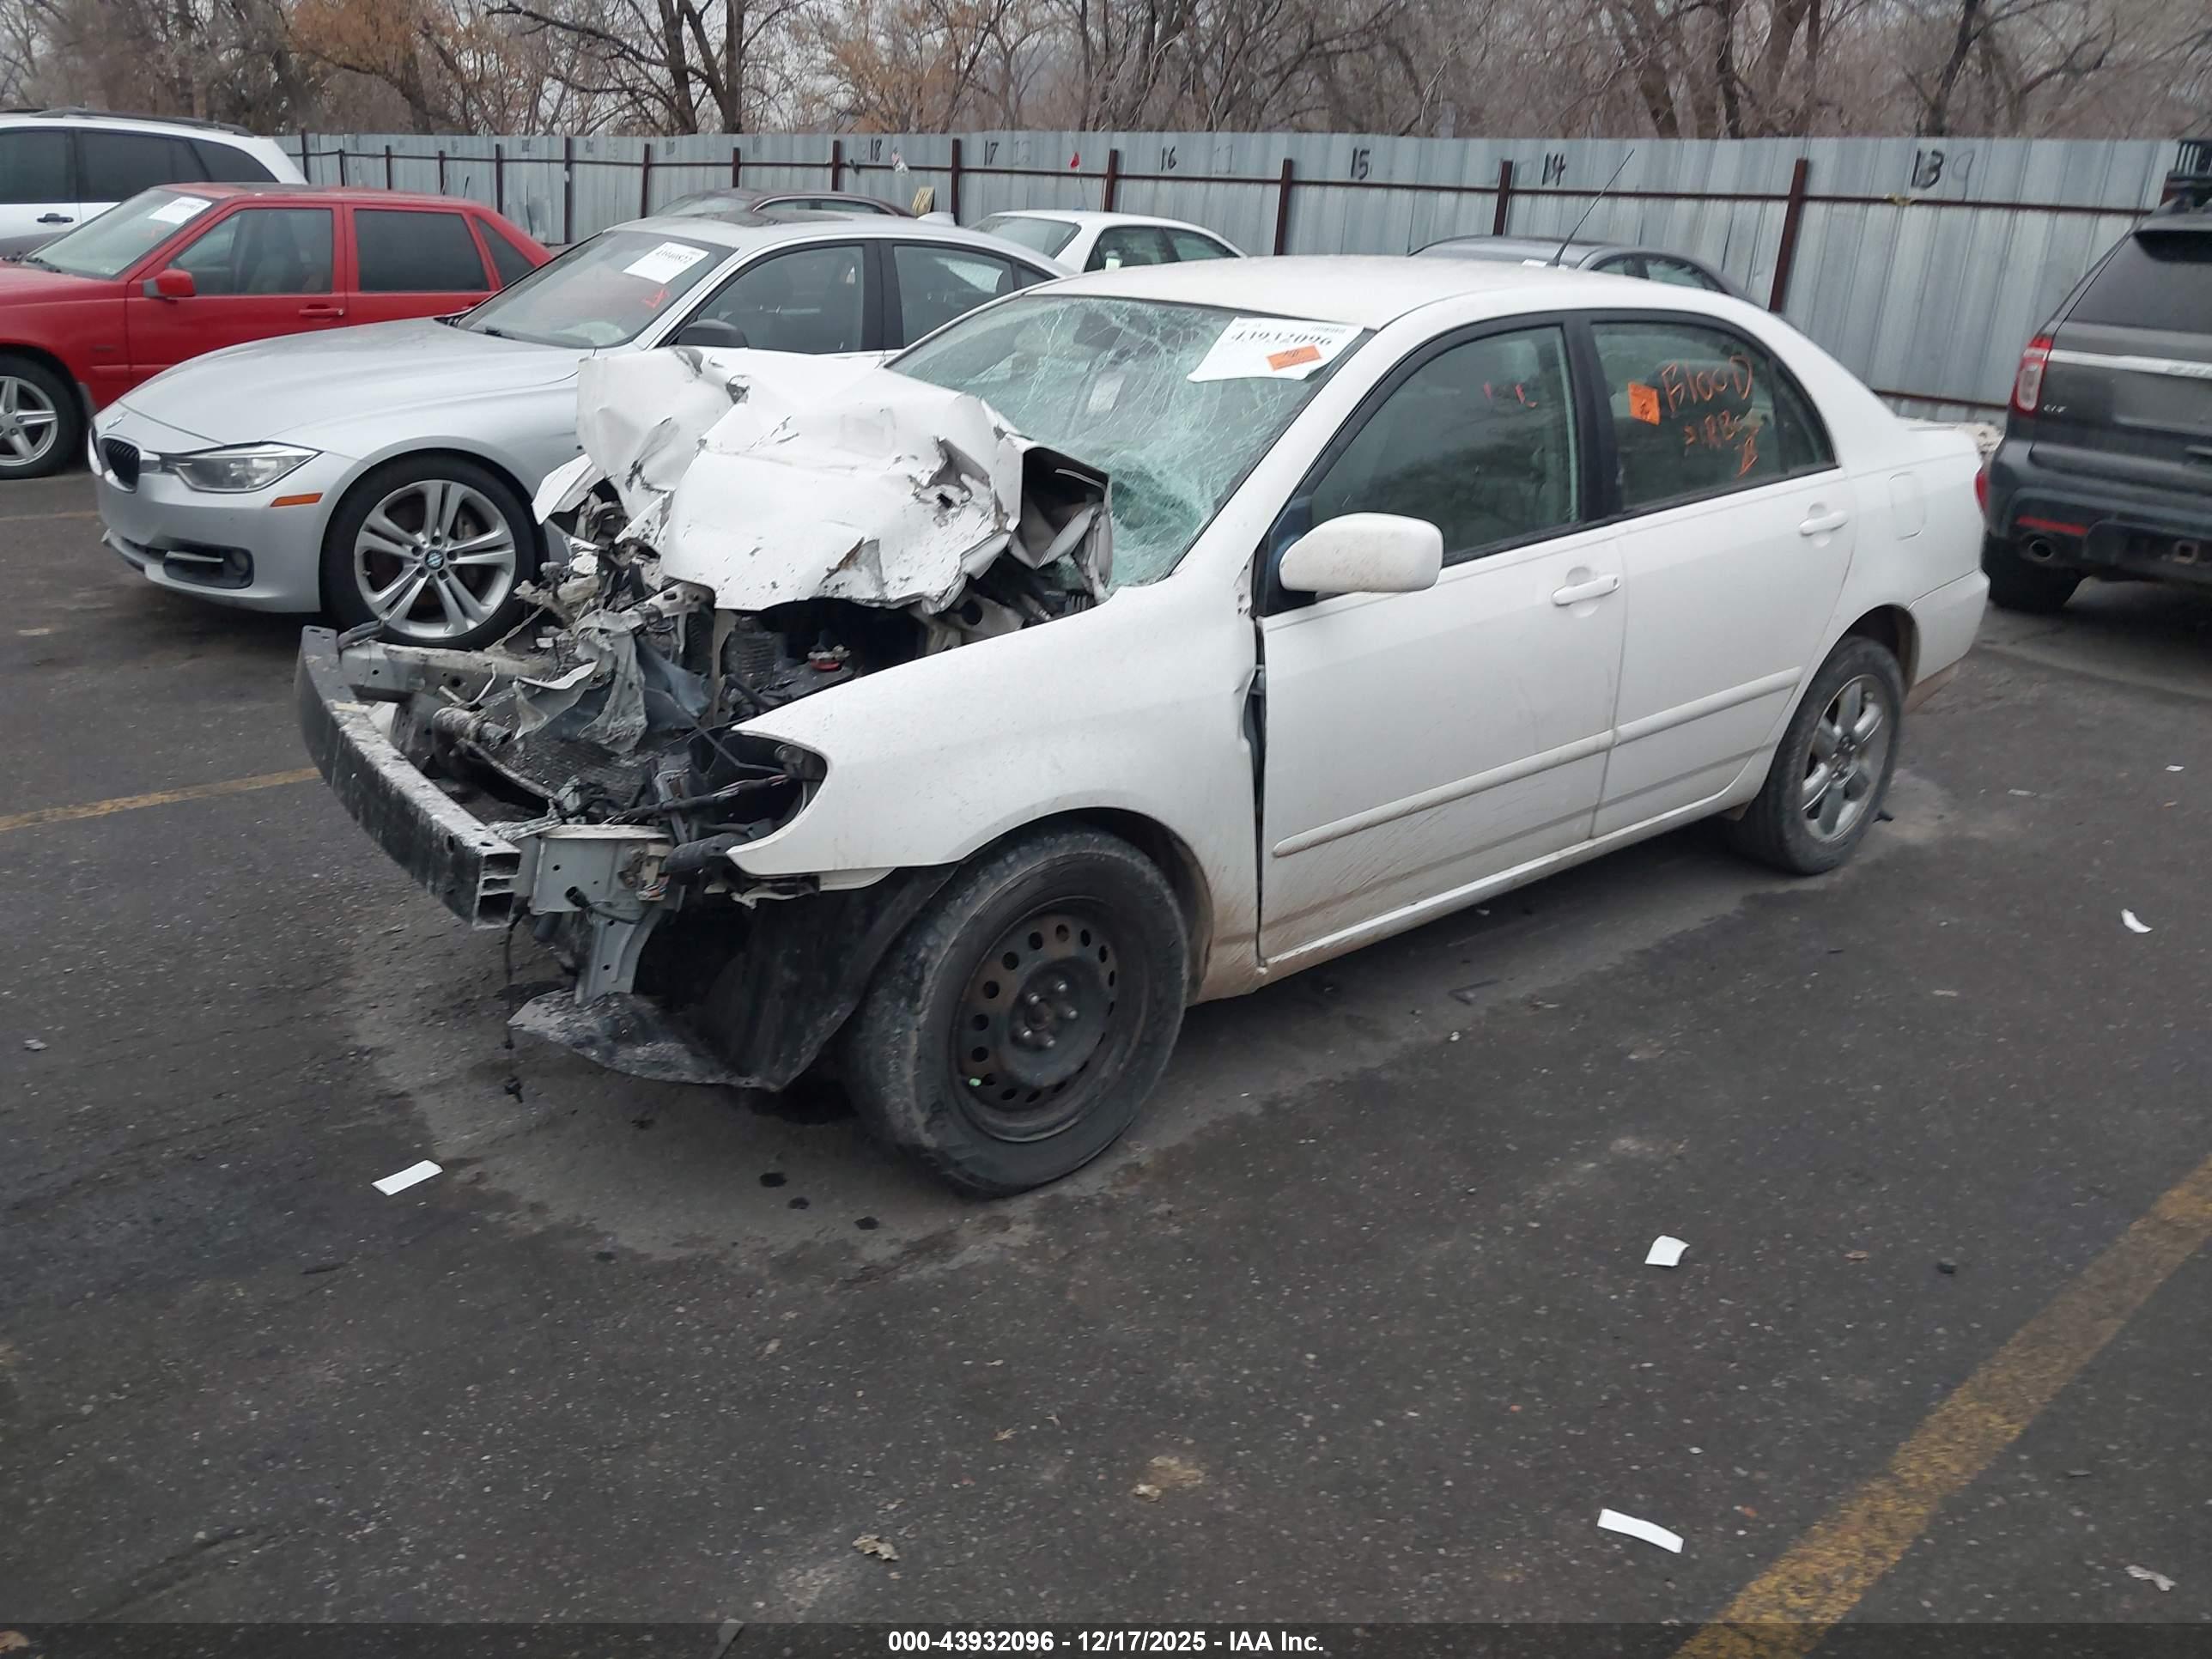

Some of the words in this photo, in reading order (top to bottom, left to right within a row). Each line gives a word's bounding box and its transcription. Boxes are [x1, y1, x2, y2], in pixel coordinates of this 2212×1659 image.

[870, 138, 883, 162] 18
[984, 141, 999, 166] 17
[1161, 146, 1177, 171] 16
[1351, 147, 1370, 180] 15
[1542, 151, 1566, 186] 14
[1911, 148, 1945, 190] 13
